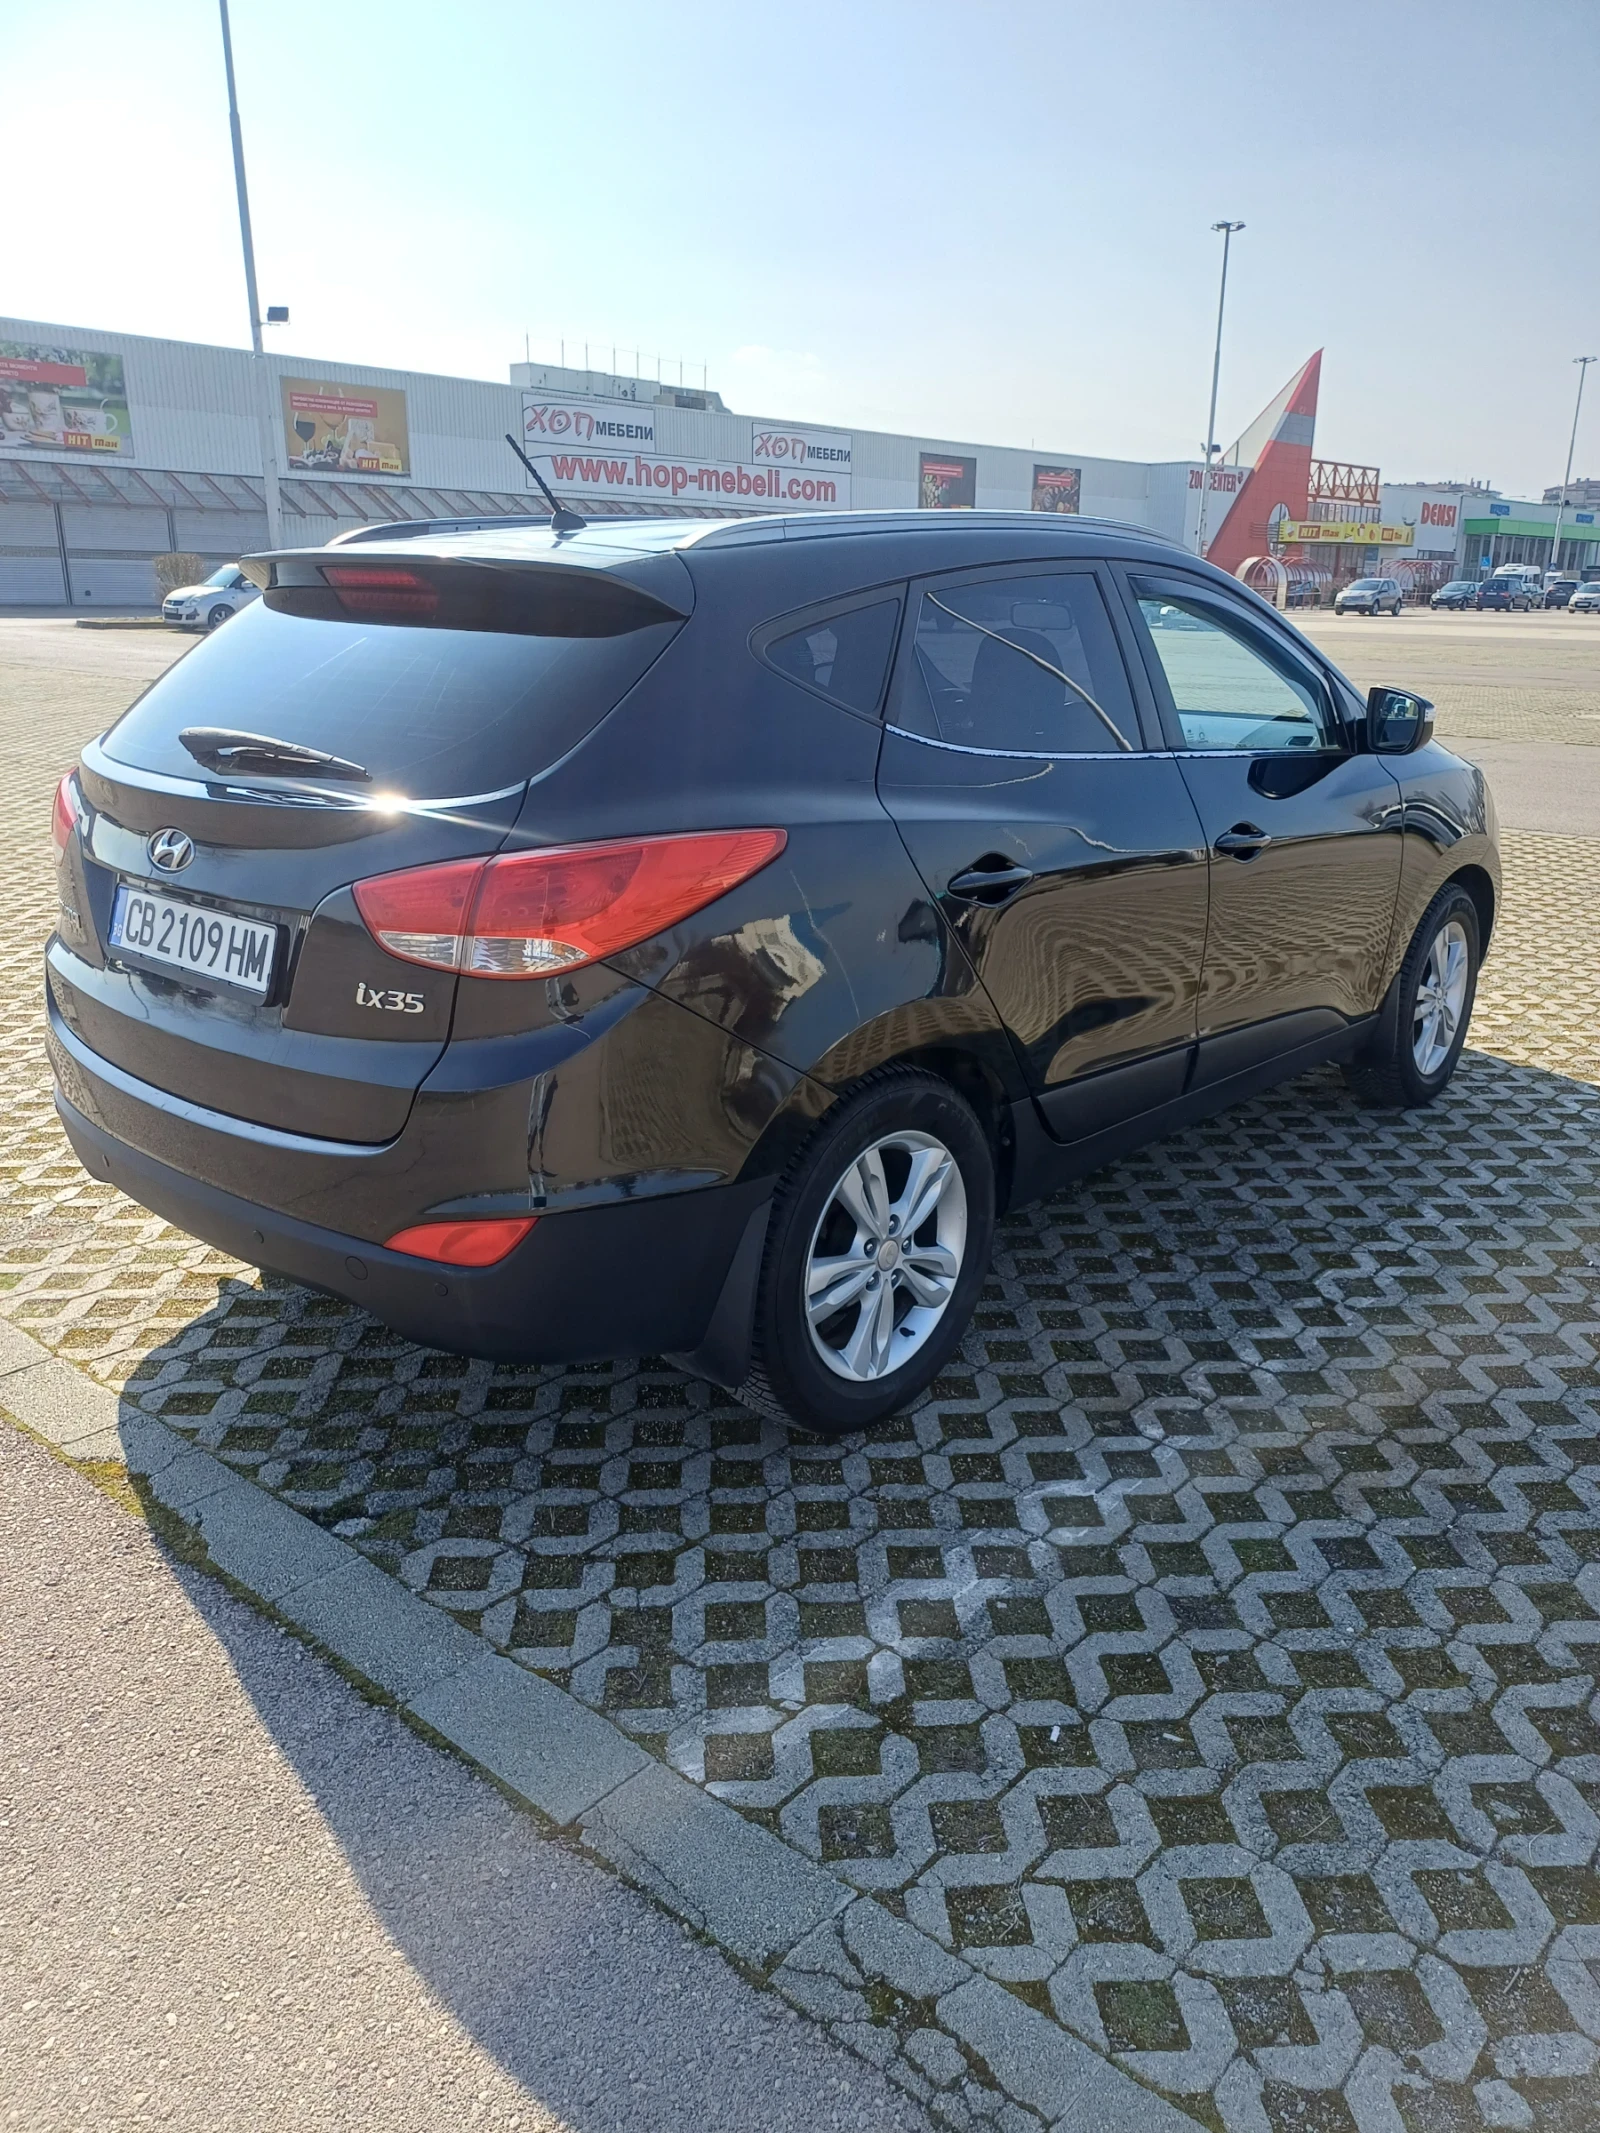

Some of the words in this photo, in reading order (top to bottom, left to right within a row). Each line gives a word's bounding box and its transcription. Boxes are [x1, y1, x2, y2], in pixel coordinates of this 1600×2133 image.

[526, 406, 595, 441] ХОП
[596, 421, 653, 441] МЕБЕЛИ
[68, 435, 88, 446] HIT
[362, 459, 378, 469] HIT
[807, 446, 851, 463] МЕБЕЛИ
[551, 455, 836, 502] www.hop-mebeli.com
[1421, 502, 1457, 527] DENSI
[356, 982, 425, 1013] ix35
